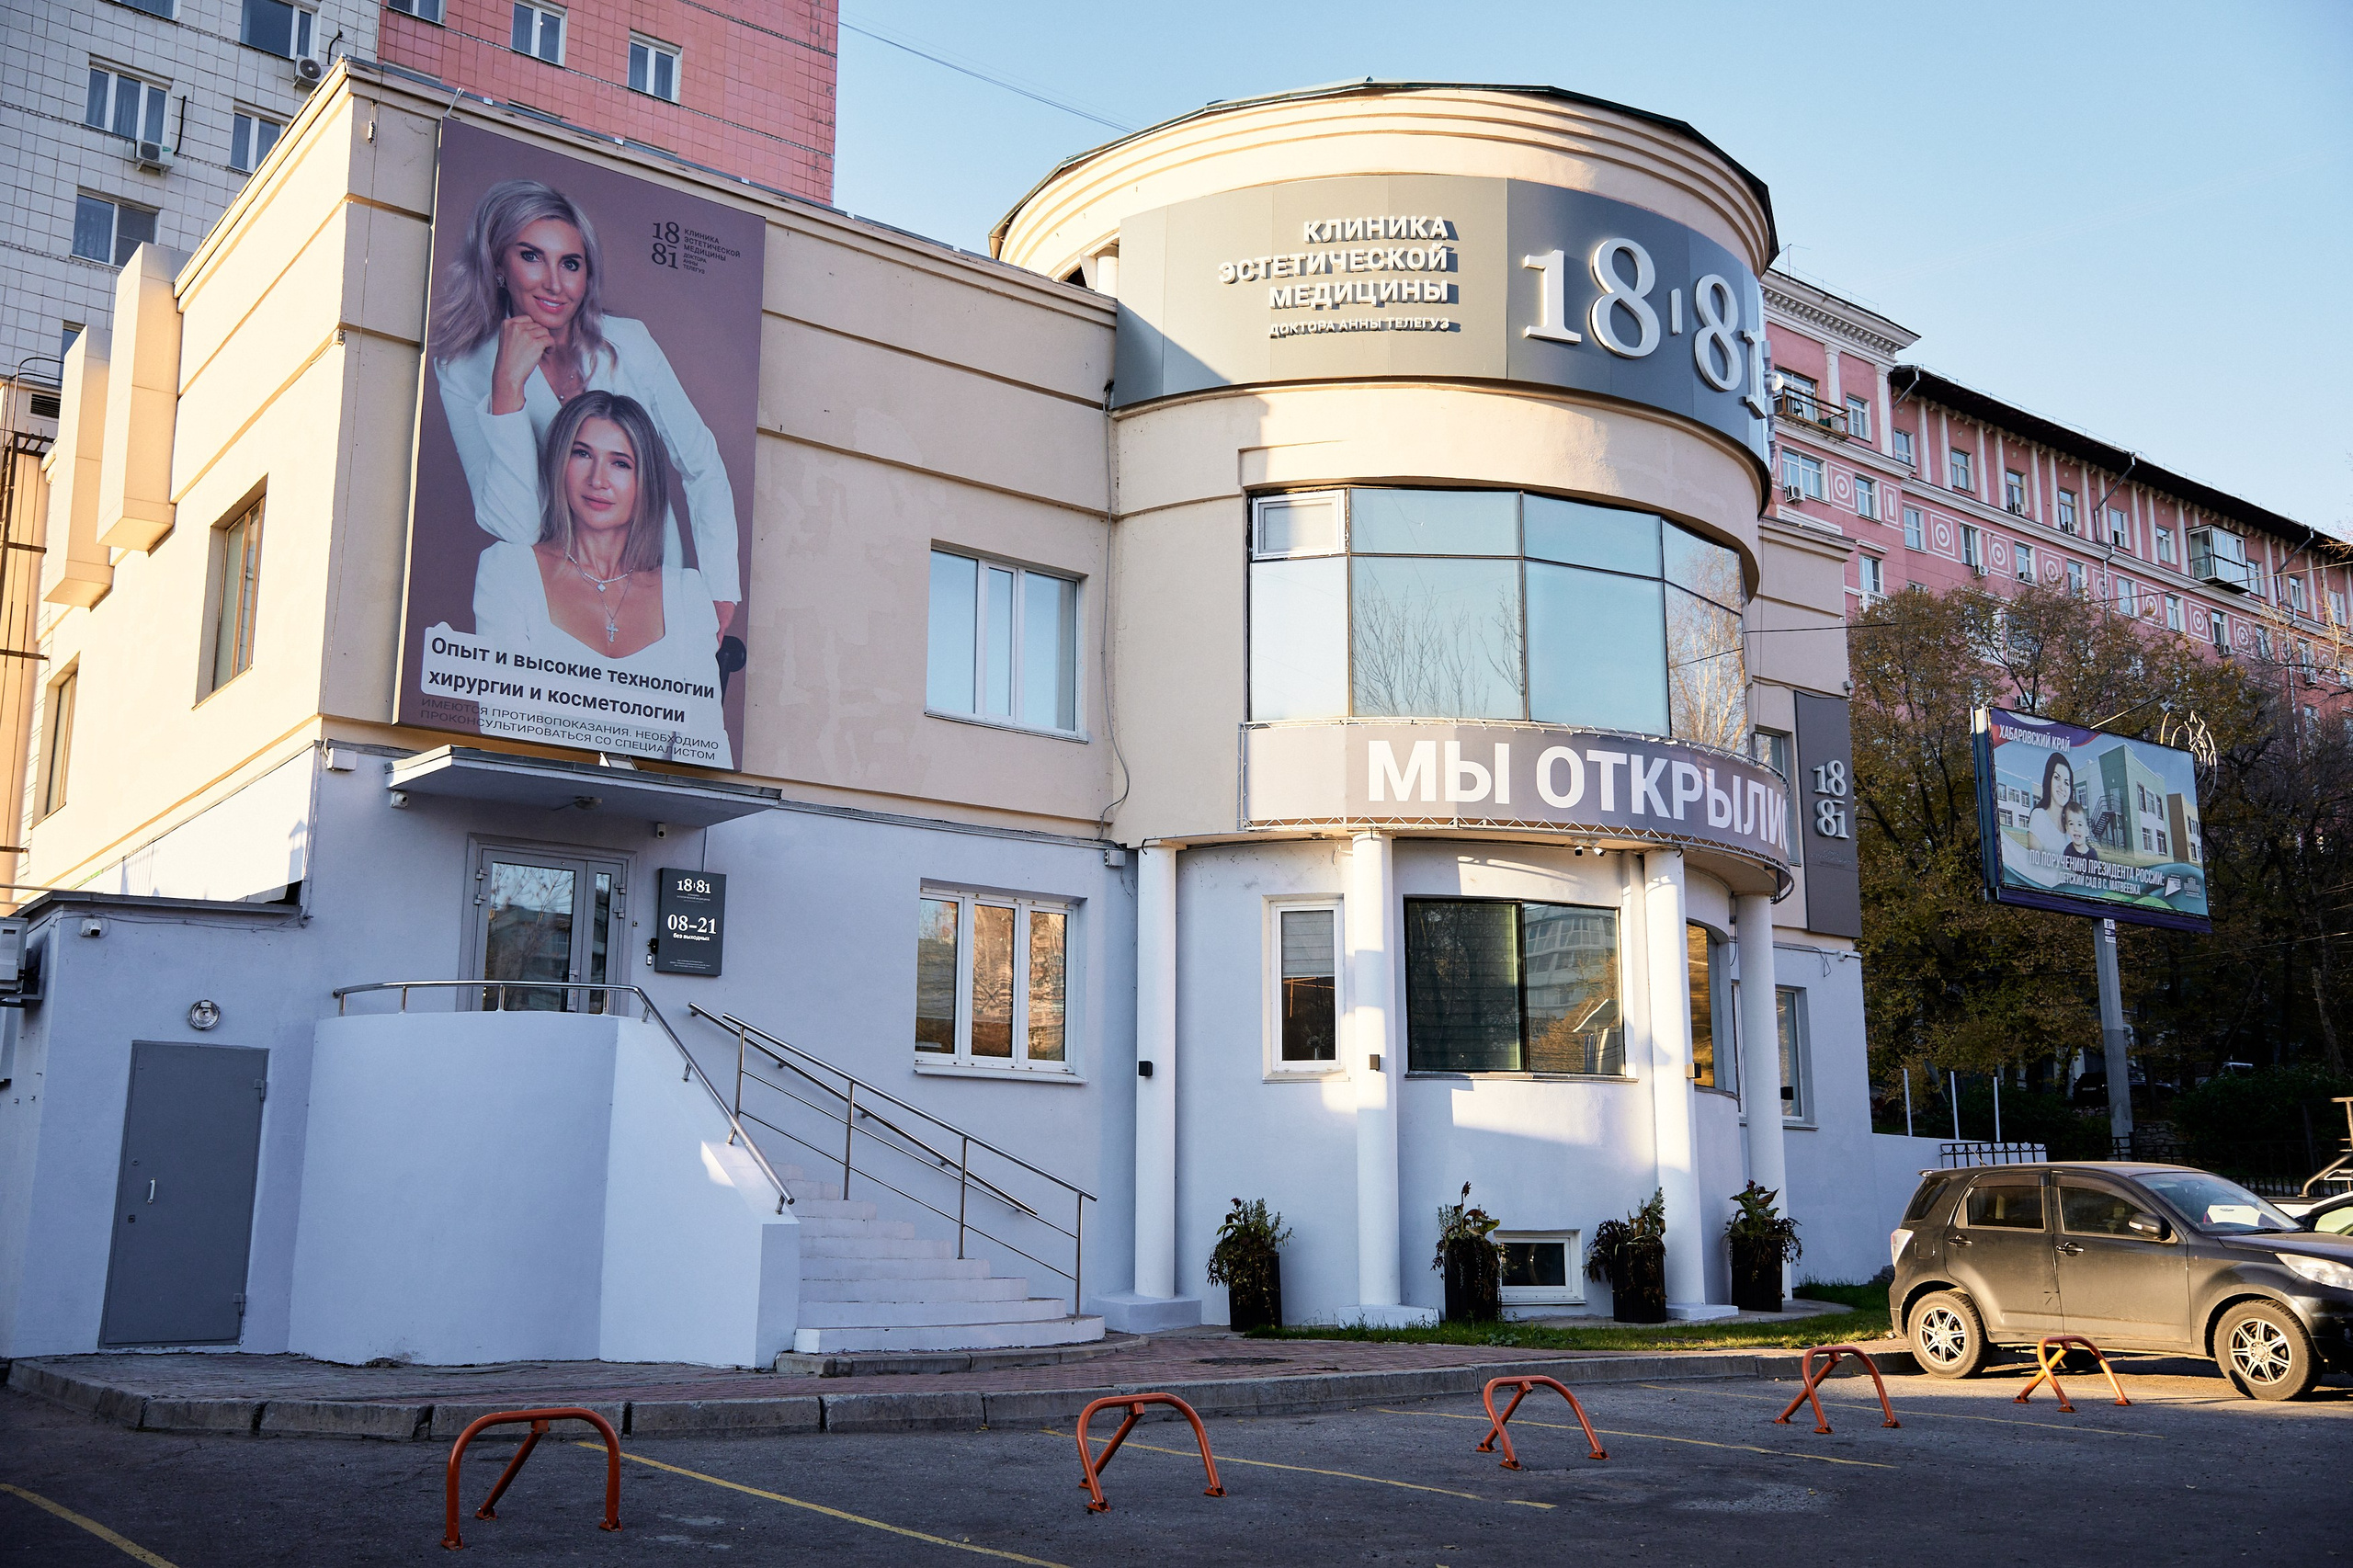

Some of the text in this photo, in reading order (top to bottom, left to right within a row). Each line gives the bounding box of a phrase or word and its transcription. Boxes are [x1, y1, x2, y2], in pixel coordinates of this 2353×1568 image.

[652, 222, 680, 244] 18
[684, 228, 720, 244] КЛИНИКА
[1303, 215, 1449, 243] КЛИНИКА
[651, 243, 678, 269] 81
[683, 244, 726, 262] МЕДИЦИНЫ
[683, 253, 707, 264] ДОКТОРА
[684, 236, 741, 257] ЭСТЕТИЧЕСКОЙ
[683, 258, 698, 267] АННЫ
[683, 263, 705, 274] ТЕЛЕГУЗ
[1218, 242, 1448, 284] ЭСТЕТИЧЕСКОЙ
[1268, 278, 1449, 310] МЕДИЦИНЫ
[1268, 316, 1450, 339] ДОКТОРА АННЫ ТЕЛЕГУЗ
[431, 637, 714, 699] Опыт и высокие технологии
[428, 670, 685, 722] хирургии и косметологии
[420, 710, 715, 760] ПРОКОНСУЛЬТИРОВАТЬСЯ СО СПЕЦИАЛИСТОМ
[421, 698, 719, 750] ИМЕЮТСЯ ПРОТИВОПОКАЗАНИЯ. НЕОБХОДИМО
[1998, 724, 2071, 753] ХАБАРОВСКИЙ КРАЙ
[1368, 740, 1510, 804] МЫ
[1813, 760, 1847, 797] 18
[1816, 799, 1849, 839] 81
[2029, 849, 2040, 865] ПО
[2040, 851, 2087, 873] ПОРУЧЕНИЮ
[2087, 859, 2133, 881] ПРЕЗИДЕНТА
[2135, 868, 2165, 886] РОССИИ:
[2059, 871, 2085, 887] ДЕТСКИЙ
[2086, 876, 2097, 889] САД
[2109, 880, 2141, 895] МАТВЕЕВКА
